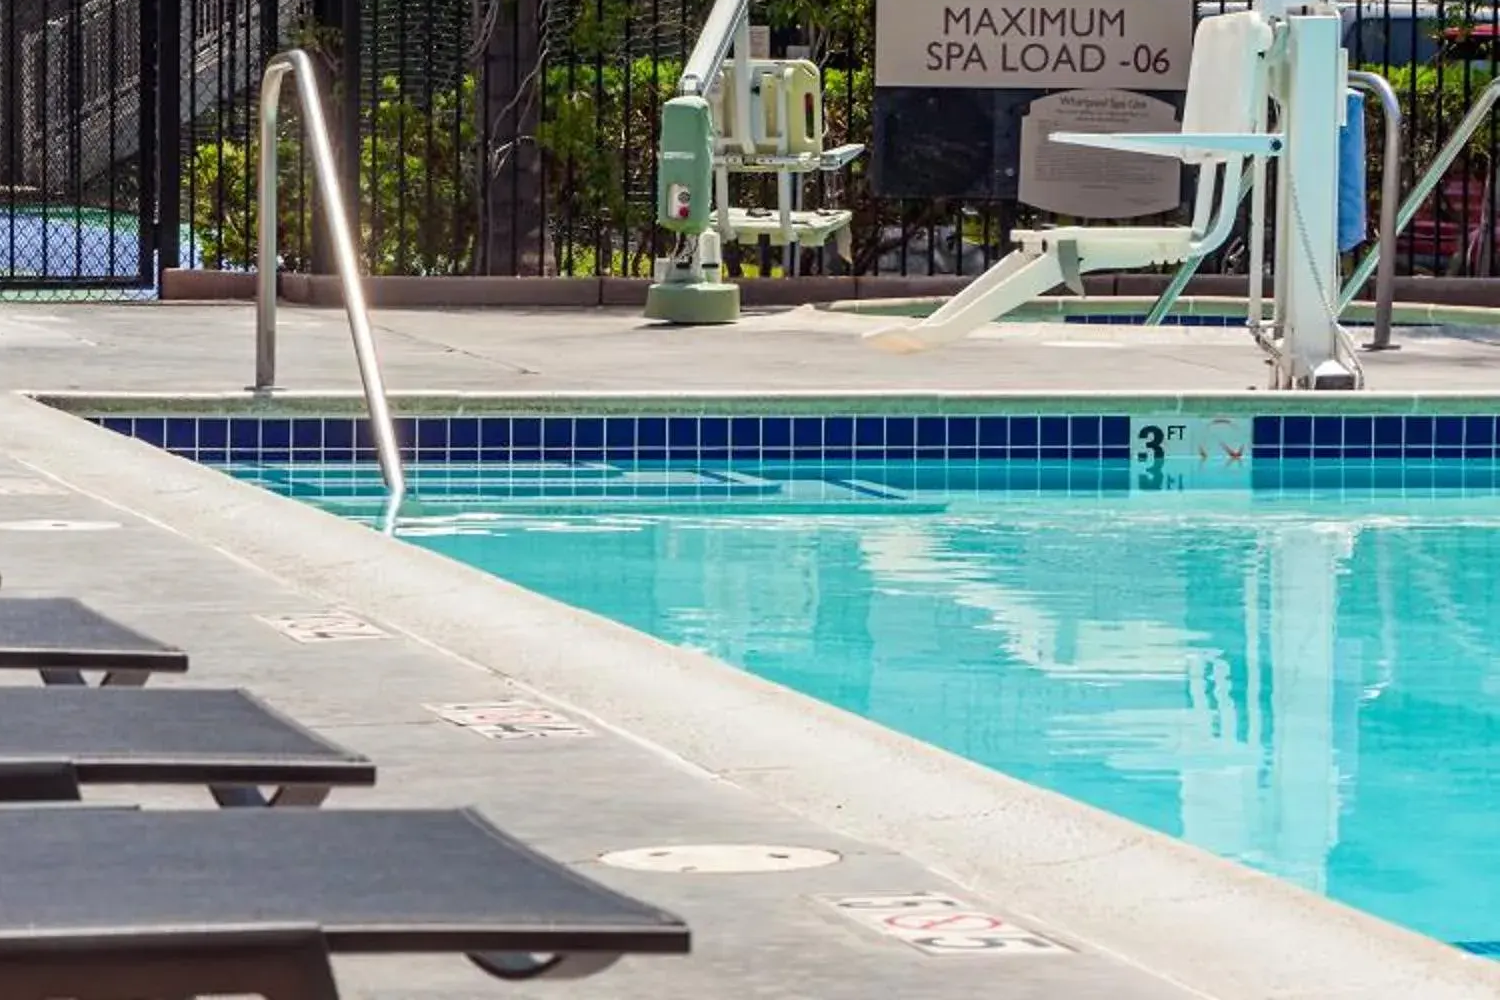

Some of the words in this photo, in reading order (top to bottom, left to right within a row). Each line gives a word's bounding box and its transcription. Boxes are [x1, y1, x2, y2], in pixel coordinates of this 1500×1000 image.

[944, 7, 1125, 37] MAXIMUM
[926, 41, 988, 71] SPA
[1001, 43, 1106, 73] LOAD
[1137, 425, 1165, 463] 3
[1167, 425, 1187, 441] FT
